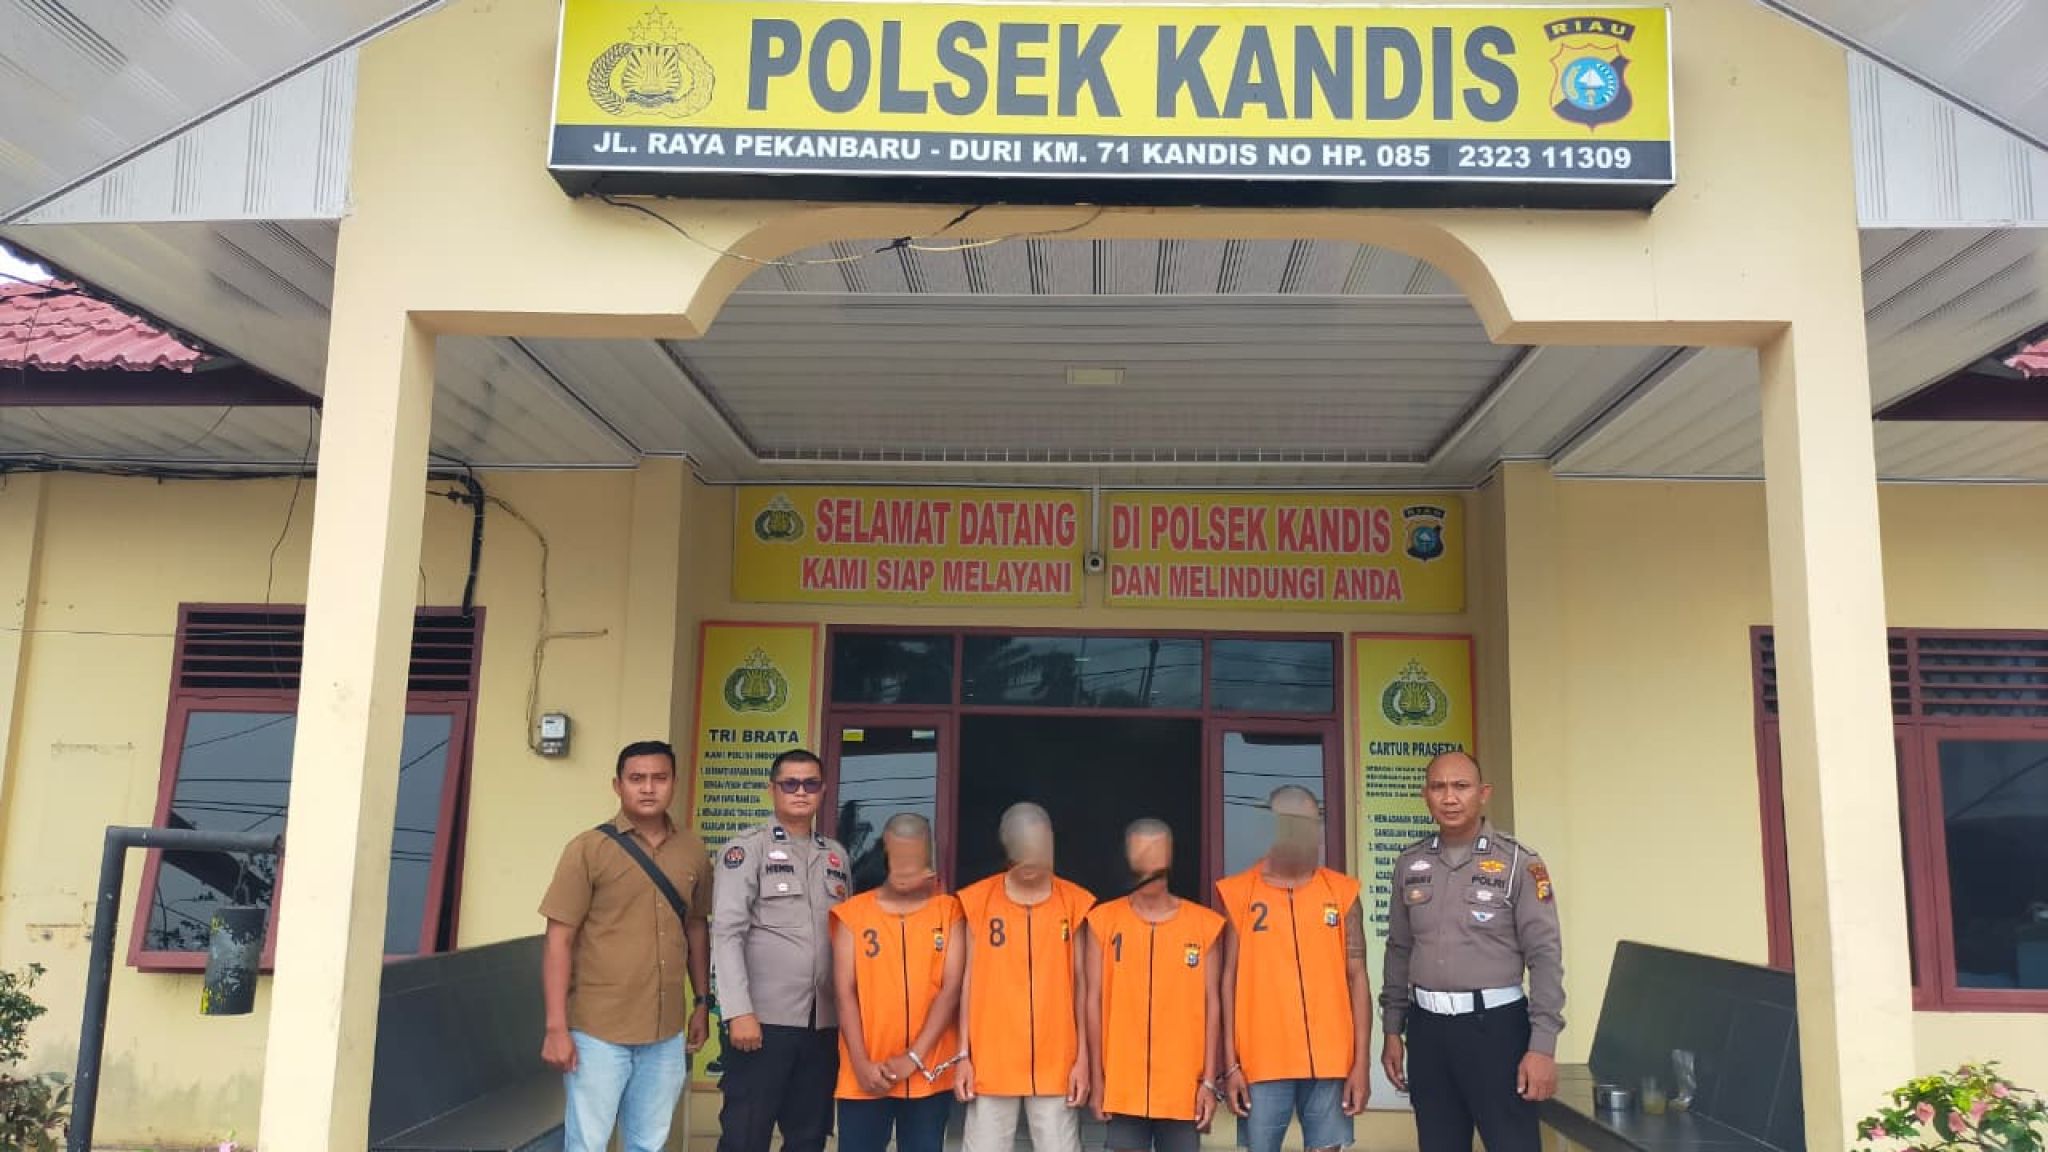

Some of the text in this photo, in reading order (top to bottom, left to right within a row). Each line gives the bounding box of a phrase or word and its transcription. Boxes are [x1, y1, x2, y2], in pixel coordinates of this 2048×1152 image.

[1551, 20, 1628, 37] RIAU
[747, 18, 1518, 122] POLSEK KANDIS
[593, 131, 637, 154] JL.
[648, 134, 725, 155] RAYA
[735, 135, 921, 159] PEKANBARU
[950, 140, 1022, 162] DURI
[1033, 141, 1088, 163] KM.
[1098, 142, 1130, 164] 71
[1143, 143, 1257, 165] KANDIS
[1268, 144, 1312, 166] NO
[1323, 145, 1366, 167] HP.
[1377, 145, 1431, 167] 085
[1458, 146, 1531, 168] 2323
[1543, 147, 1632, 169] 11309
[816, 499, 1076, 547] SELAMAT DATANG
[1113, 505, 1391, 553] DI POLSEK KANDIS
[802, 558, 1072, 593] KAMI SIAP MELAYANI
[1112, 566, 1402, 601] DAN MELINDUNGI ANDA
[709, 729, 799, 743] TRI BRATA
[1369, 742, 1410, 756] CARTUR
[1471, 875, 1505, 888] POLRI
[1250, 902, 1268, 932] 2
[863, 928, 880, 958] 3
[989, 918, 1006, 947] 8
[1111, 932, 1122, 962] 1
